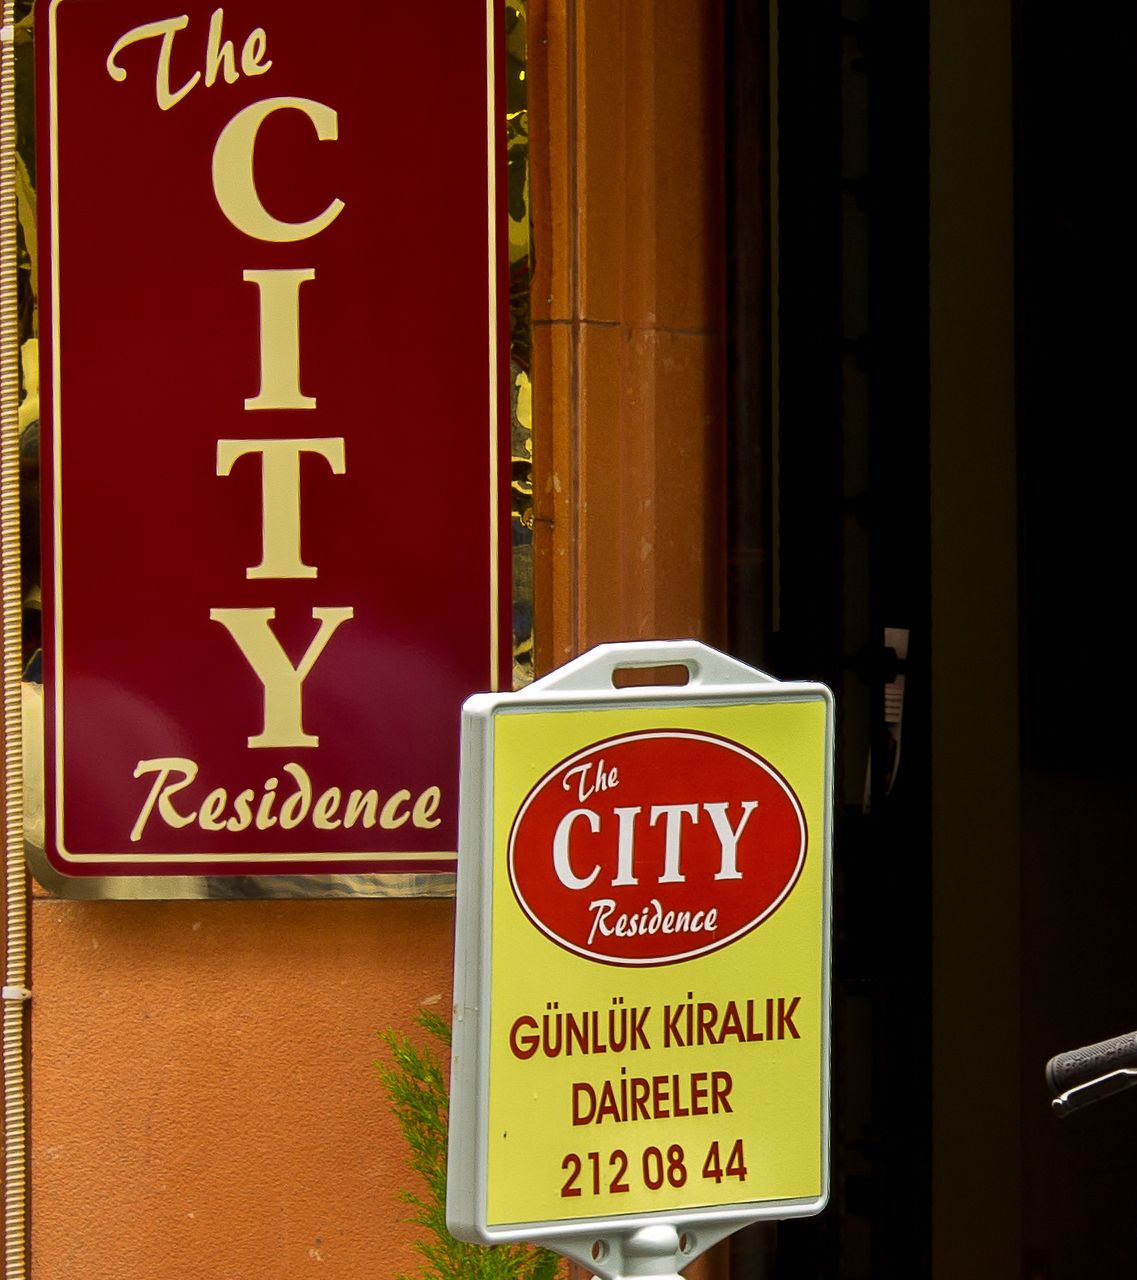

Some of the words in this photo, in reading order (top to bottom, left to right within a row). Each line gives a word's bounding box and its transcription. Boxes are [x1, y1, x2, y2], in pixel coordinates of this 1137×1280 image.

[107, 8, 272, 110] The
[211, 96, 354, 748] CITY
[131, 758, 441, 841] Residence
[563, 759, 619, 803] The
[553, 801, 758, 889] CITY
[587, 899, 717, 945] Residence
[510, 996, 651, 1060] GÜNLÜK
[664, 991, 801, 1048] KİRALIK
[572, 1066, 733, 1126] DAİRELER
[561, 1150, 629, 1197] 212
[643, 1144, 687, 1190] 08
[703, 1138, 747, 1183] 44
